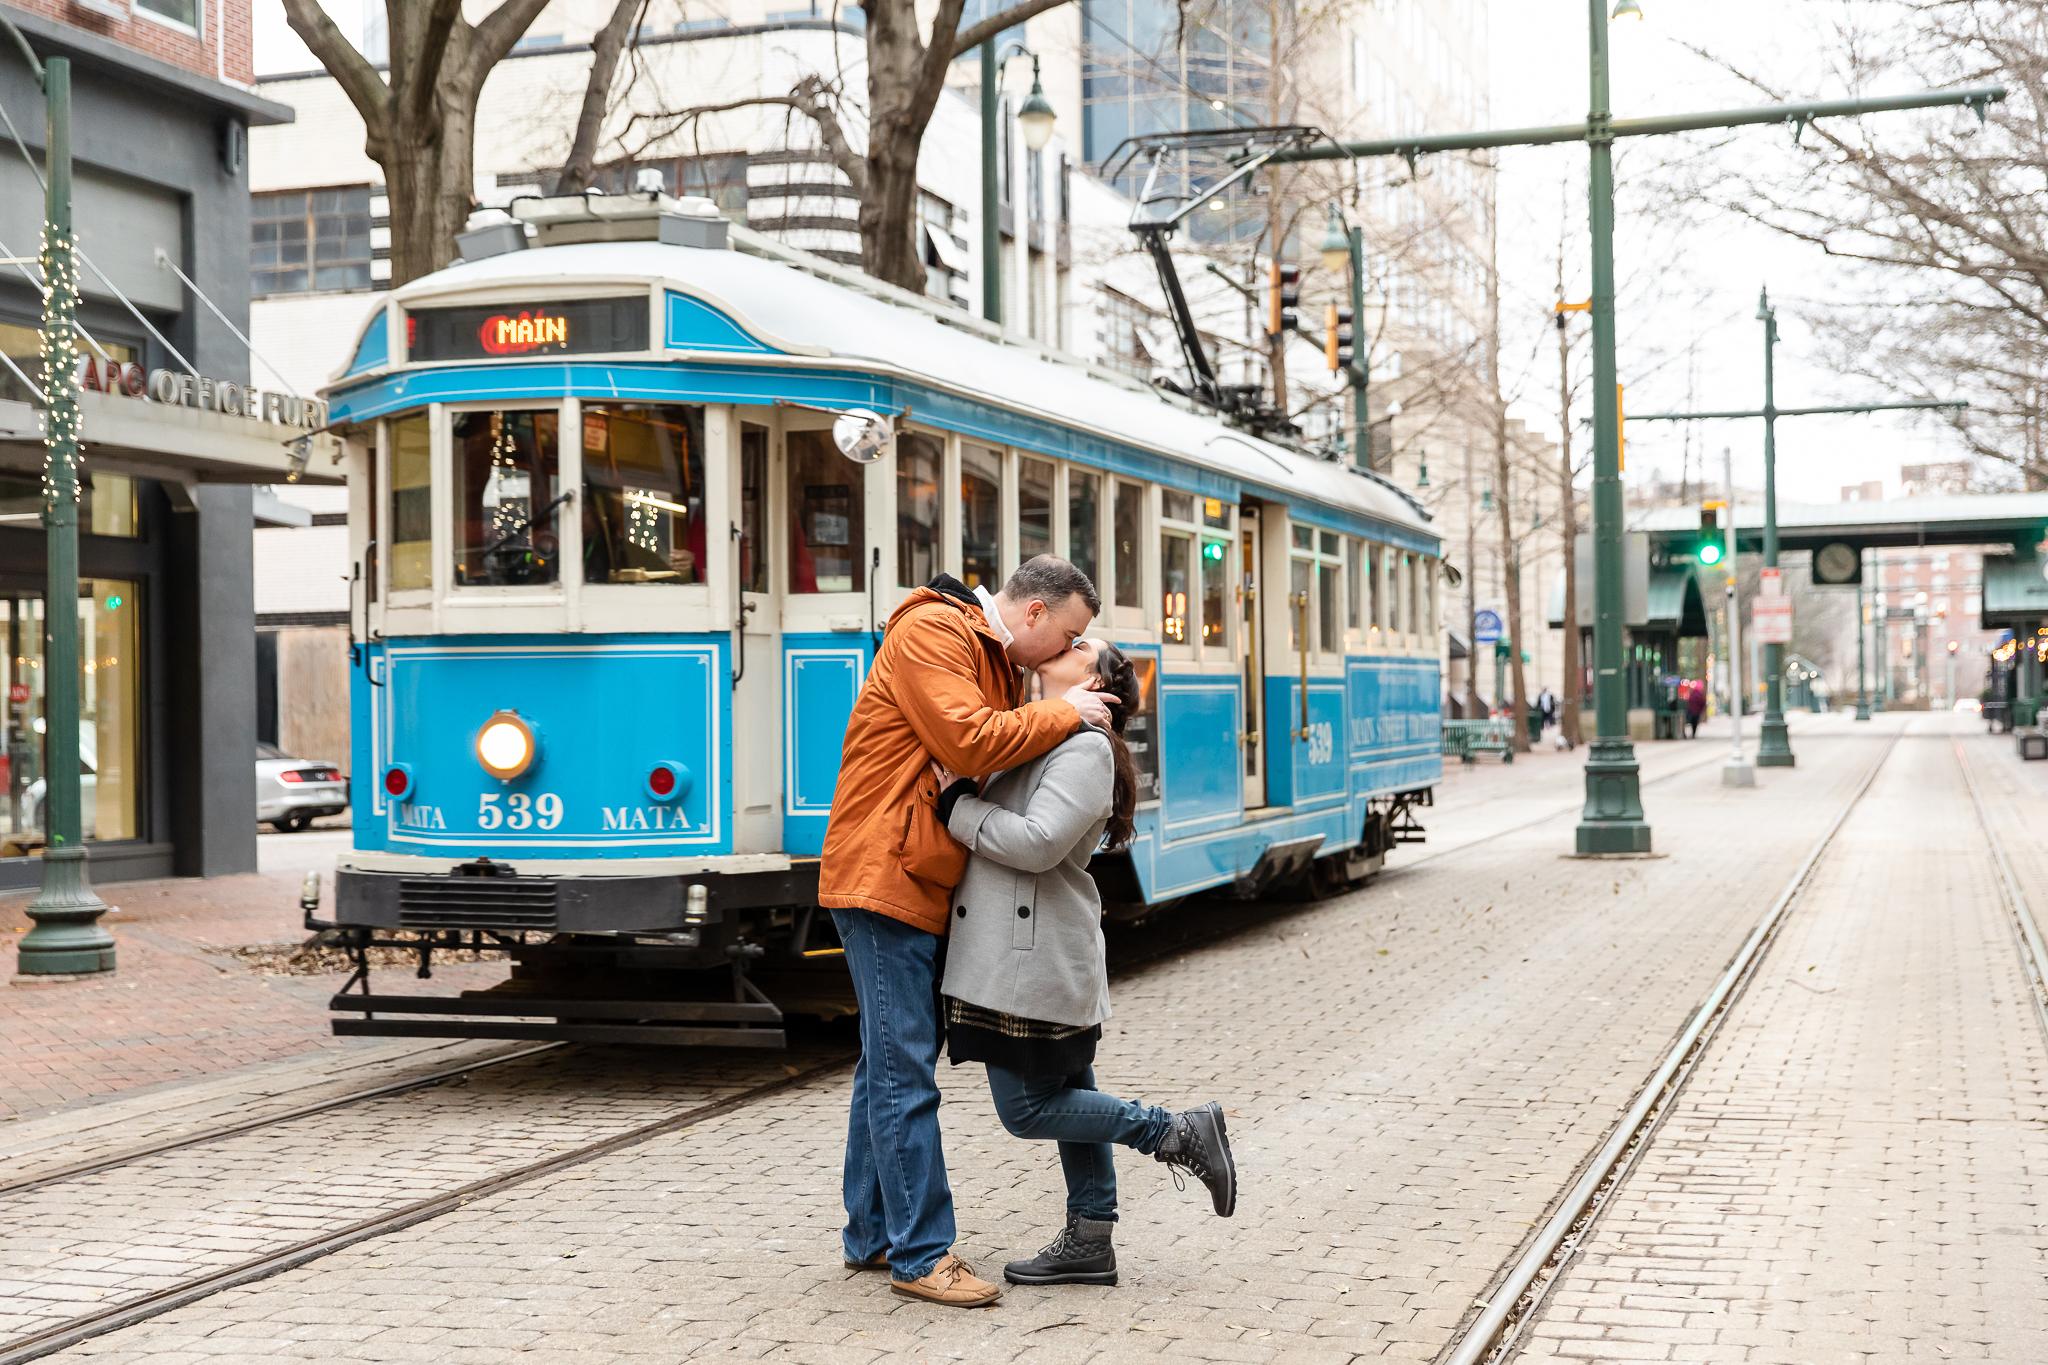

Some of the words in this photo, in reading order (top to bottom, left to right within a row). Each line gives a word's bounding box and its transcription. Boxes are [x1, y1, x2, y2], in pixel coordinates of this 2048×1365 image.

[497, 317, 567, 345] MAIN
[79, 352, 147, 398] APG
[150, 368, 258, 420] OFFICE
[1308, 721, 1333, 766] 539
[401, 803, 447, 830] MATA
[477, 792, 564, 830] 539
[602, 805, 691, 831] MATA
